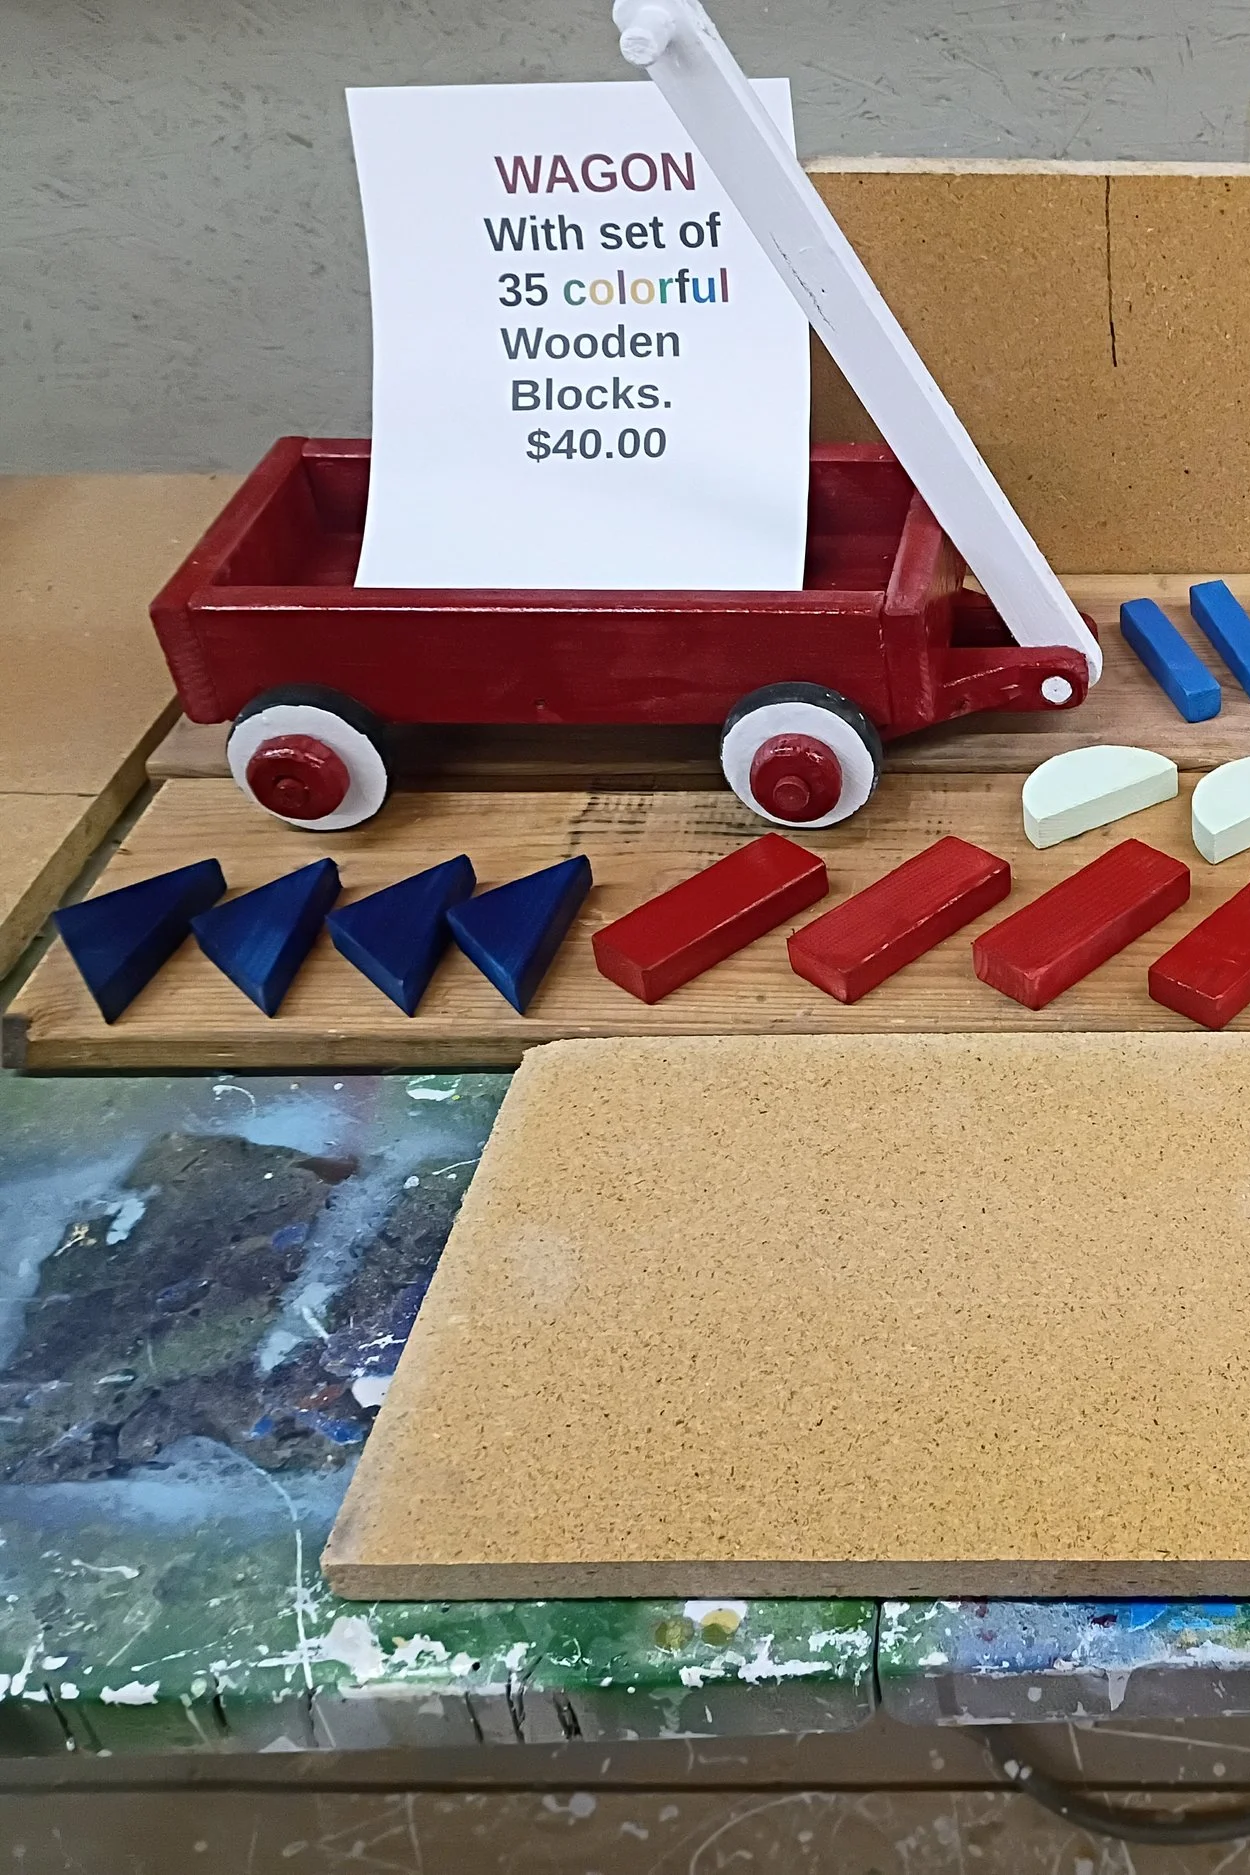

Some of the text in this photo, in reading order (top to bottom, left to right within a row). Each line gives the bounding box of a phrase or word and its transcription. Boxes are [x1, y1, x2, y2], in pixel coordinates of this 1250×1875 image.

[494, 152, 696, 195] WAGON
[484, 212, 721, 252] With set of
[499, 268, 729, 307] 35 colorful
[500, 324, 680, 360] Wooden
[512, 377, 672, 412] Blocks.
[526, 428, 667, 464] $40.00
